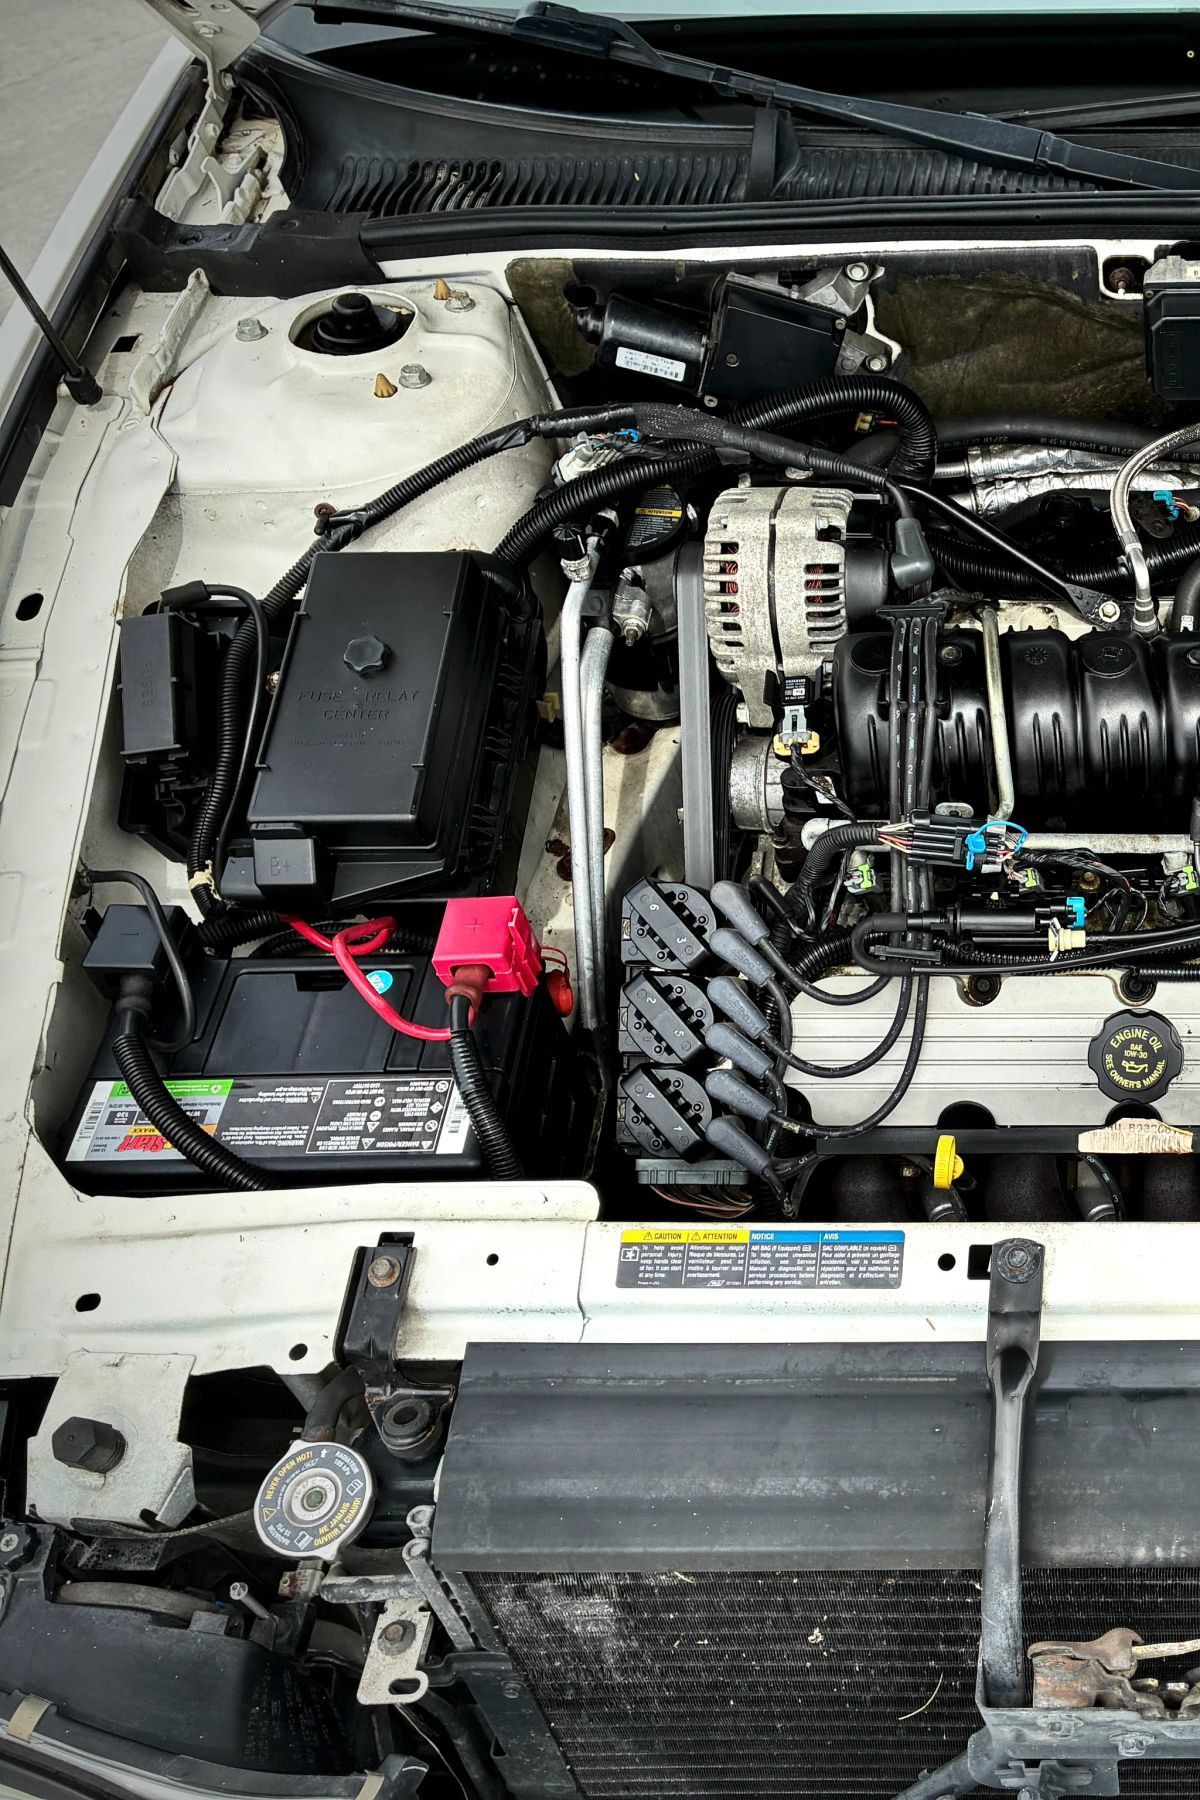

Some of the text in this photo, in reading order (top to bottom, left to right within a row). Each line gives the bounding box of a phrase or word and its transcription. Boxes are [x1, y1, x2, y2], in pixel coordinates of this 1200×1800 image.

[299, 690, 419, 701] FUSE RELAY
[323, 709, 390, 720] CENTER
[676, 936, 687, 944] 3
[1110, 1028, 1163, 1053] ENGINE OIL
[1124, 1050, 1148, 1058] 10W-30
[1105, 1054, 1166, 1089] SEE OWNER'S MANUAL
[117, 1135, 165, 1152] Start
[336, 1451, 360, 1474] RADIATEUR
[266, 1451, 313, 1500] NEVER OPEN HOT!
[314, 1528, 340, 1546] OUVRIR
[344, 1497, 361, 1523] CHAUD!
[319, 1502, 350, 1535] NE JAMAIS
[267, 1524, 290, 1546] RADIATOR
